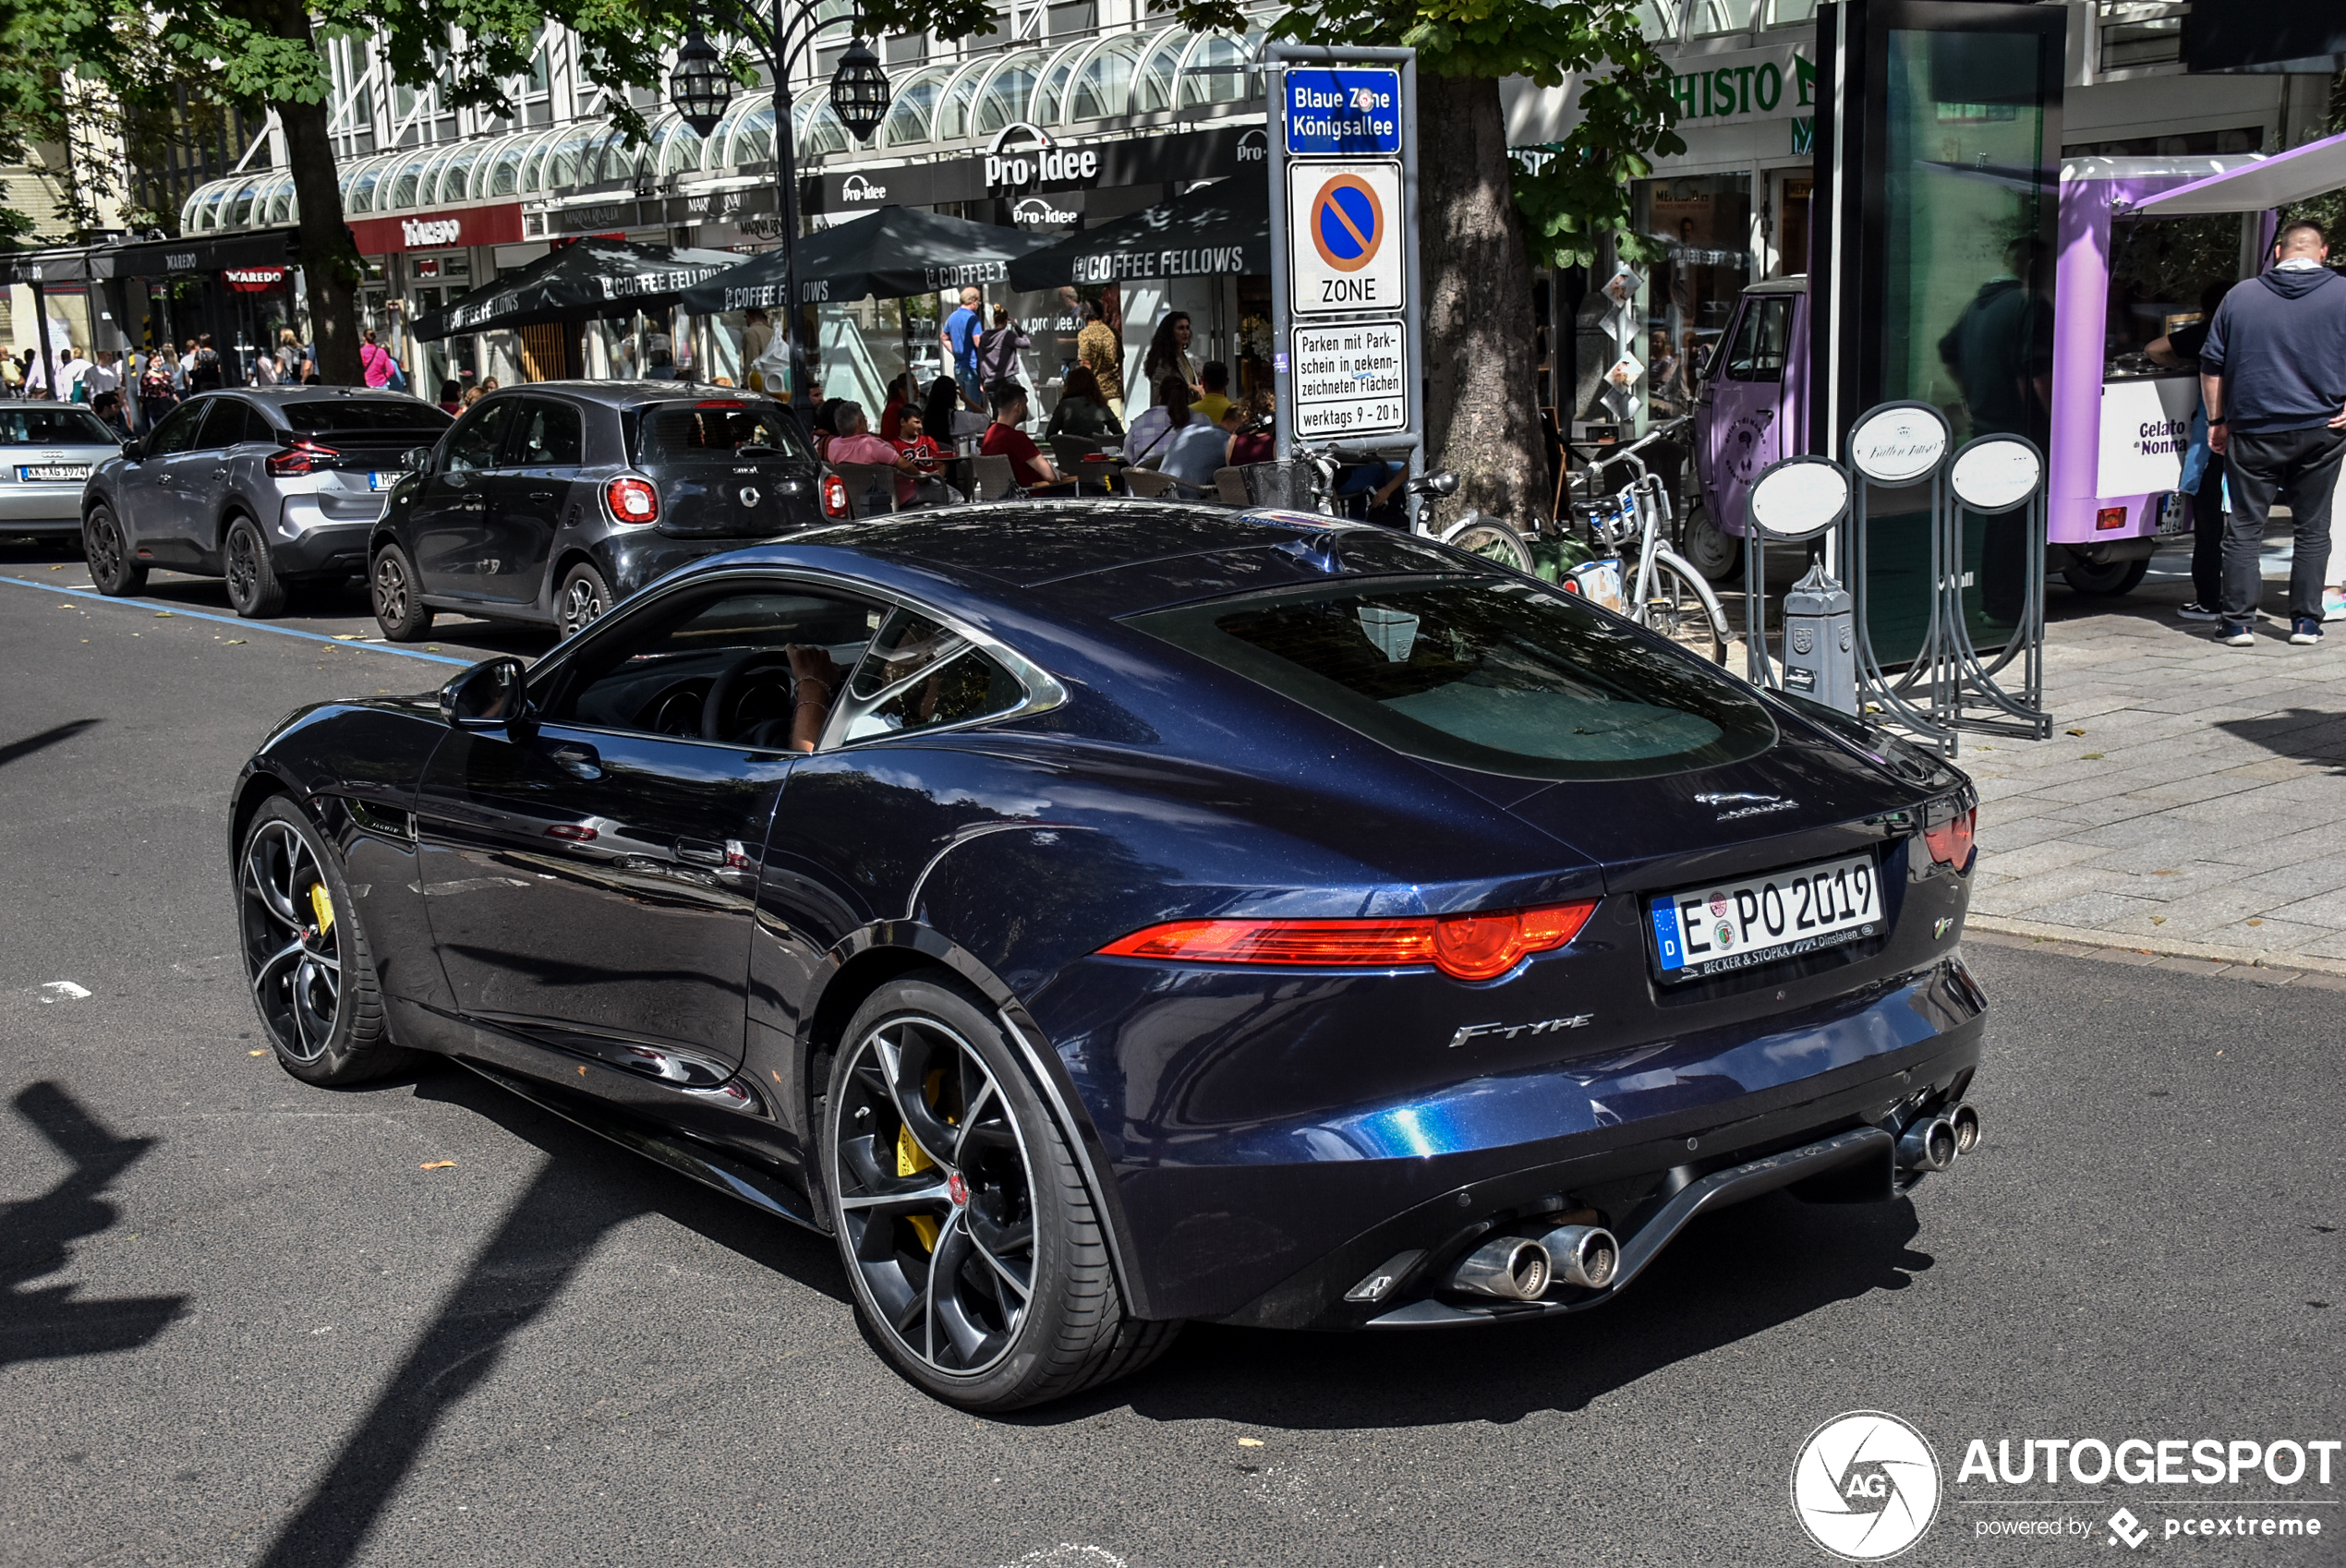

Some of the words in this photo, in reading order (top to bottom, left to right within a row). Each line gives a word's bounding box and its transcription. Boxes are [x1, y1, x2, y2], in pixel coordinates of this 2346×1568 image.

[1294, 87, 1343, 108] Blaue
[1348, 87, 1390, 108] Zne
[1293, 115, 1393, 141] Königsallee
[564, 209, 592, 224] MARINA
[592, 205, 621, 222] RINALDI
[401, 219, 460, 247] MAREDO
[740, 220, 769, 235] MARINA
[165, 252, 197, 271] MAREDO
[1087, 251, 1155, 281] COFFEE
[1160, 246, 1243, 276] FELLOWS
[224, 271, 283, 283] MAREDO
[613, 271, 667, 296] COFFEE
[939, 262, 996, 288] COFFEE
[734, 285, 778, 308] COFFEE
[1322, 278, 1376, 303] ZONE
[449, 303, 481, 331] COFFEE
[481, 293, 519, 320] FELLOWS
[1301, 335, 1339, 353] Parken
[1343, 333, 1361, 351] mit
[1366, 330, 1397, 349] Park-
[1300, 357, 1335, 375] schein
[1339, 356, 1349, 372] in
[1354, 354, 1398, 374] gekenn-
[1301, 379, 1356, 397] zeichneten
[1360, 375, 1399, 393] Flächen
[1303, 409, 1353, 428] werktags
[1357, 406, 1363, 423] 9
[1376, 404, 1389, 421] 20
[1393, 404, 1399, 419] h
[2140, 419, 2185, 438] Gelato
[2141, 439, 2188, 455] Nonna
[29, 466, 41, 476] KK
[48, 466, 61, 476] XG
[62, 465, 86, 476] 1974
[732, 465, 760, 474] smart
[370, 822, 399, 834] JAGUAR
[1679, 898, 1711, 955] E
[1732, 882, 1784, 944] PO
[1791, 863, 1872, 931] 2019
[1664, 939, 1675, 956] D
[1703, 952, 1742, 974] BECKER
[1742, 953, 1751, 966] &
[1751, 945, 1790, 965] STOPKA
[1818, 928, 1858, 948] Dinslaken
[1448, 1013, 1595, 1049] F-TYPE
